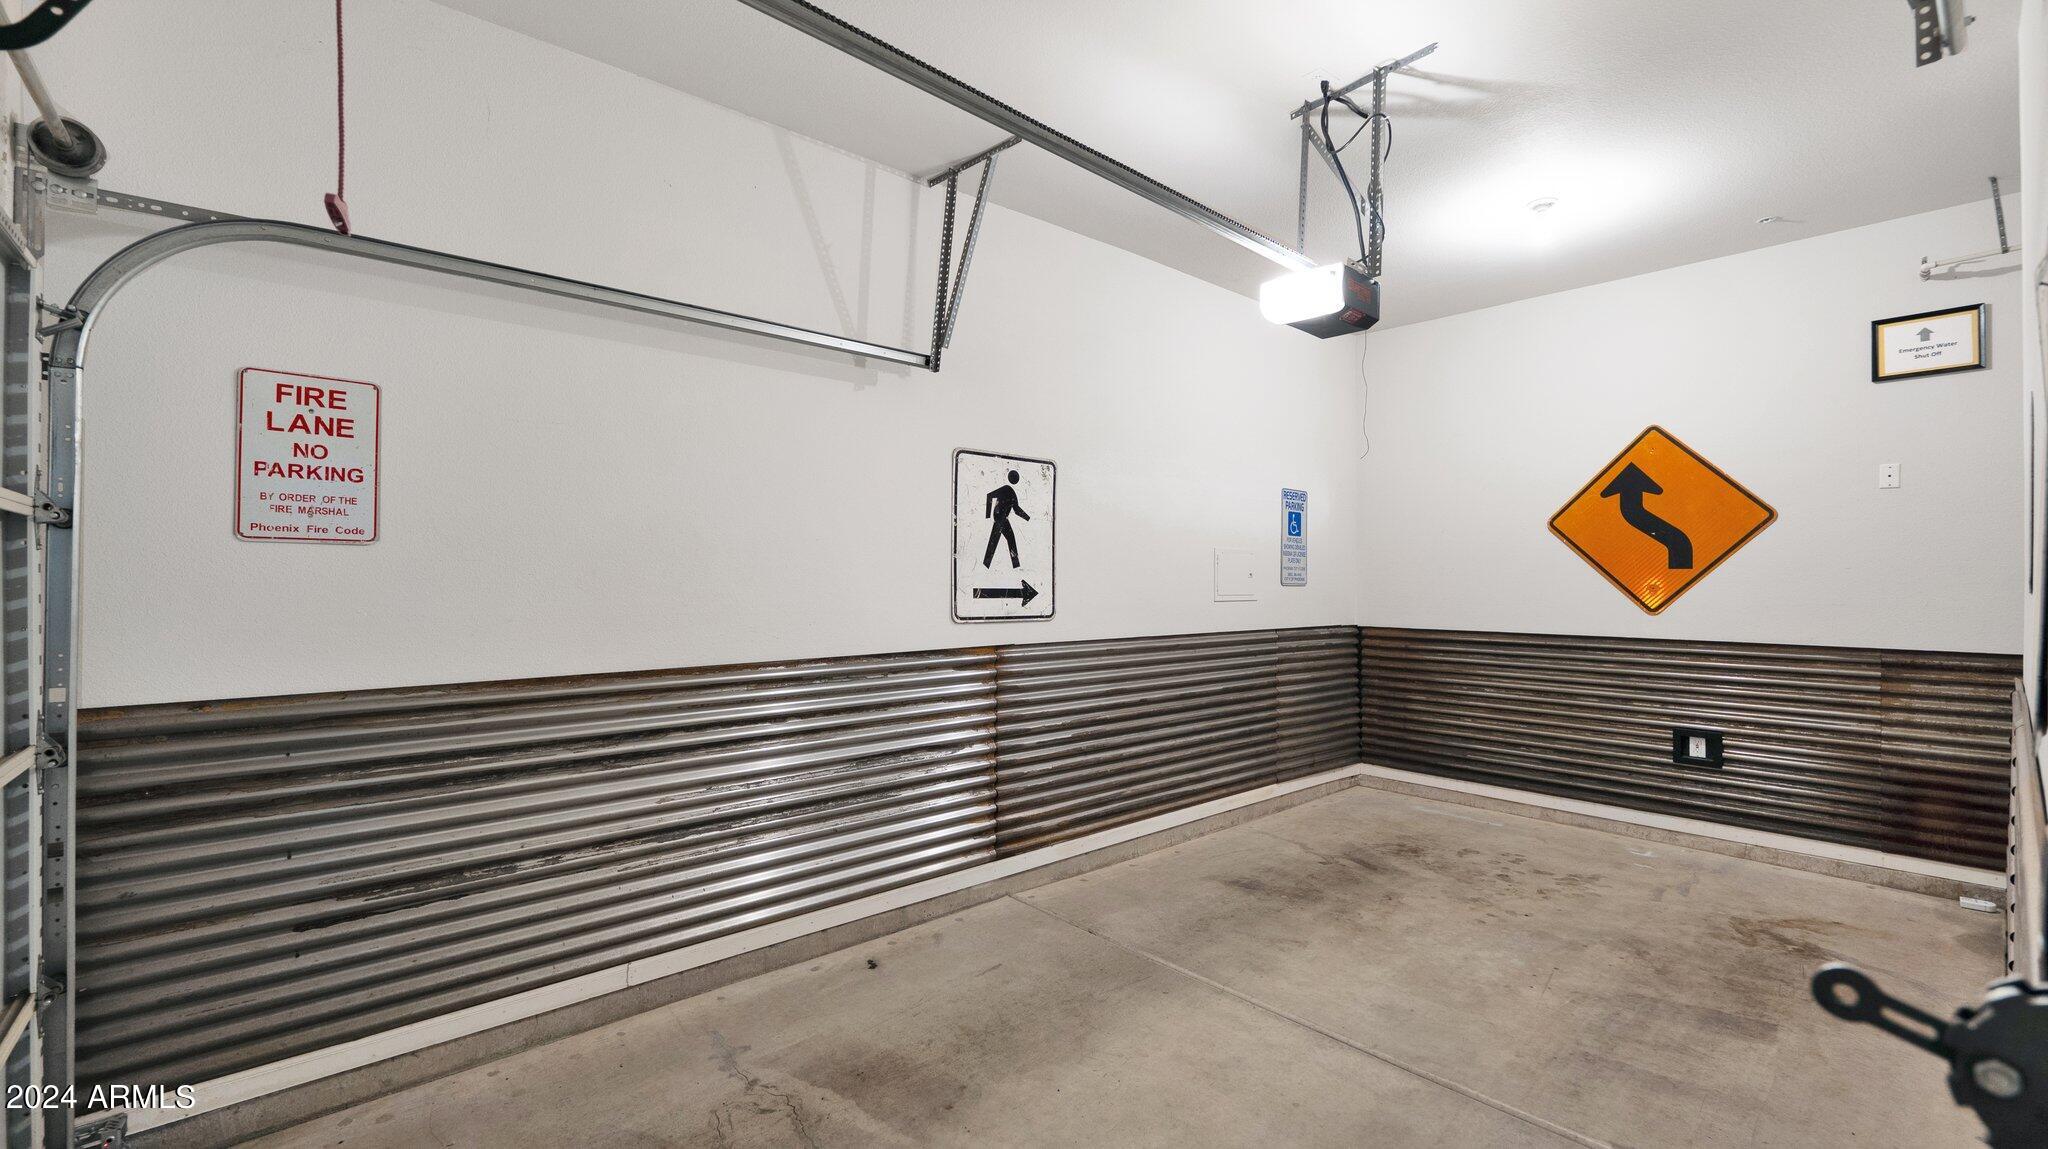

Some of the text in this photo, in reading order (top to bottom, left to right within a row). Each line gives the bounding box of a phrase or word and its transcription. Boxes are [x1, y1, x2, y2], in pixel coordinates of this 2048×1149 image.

[1898, 341, 1958, 353] Emergency Water
[275, 383, 347, 410] FIRE
[266, 410, 355, 438] LANE
[293, 442, 328, 460] NO
[253, 460, 364, 483] PARKING
[260, 491, 358, 506] BY ORDER OF THE
[1283, 490, 1307, 502] RESERVED
[269, 504, 349, 517] FIRE MARSHAL
[1285, 500, 1304, 512] PARKING
[250, 522, 365, 536] Phoenix Fire Code
